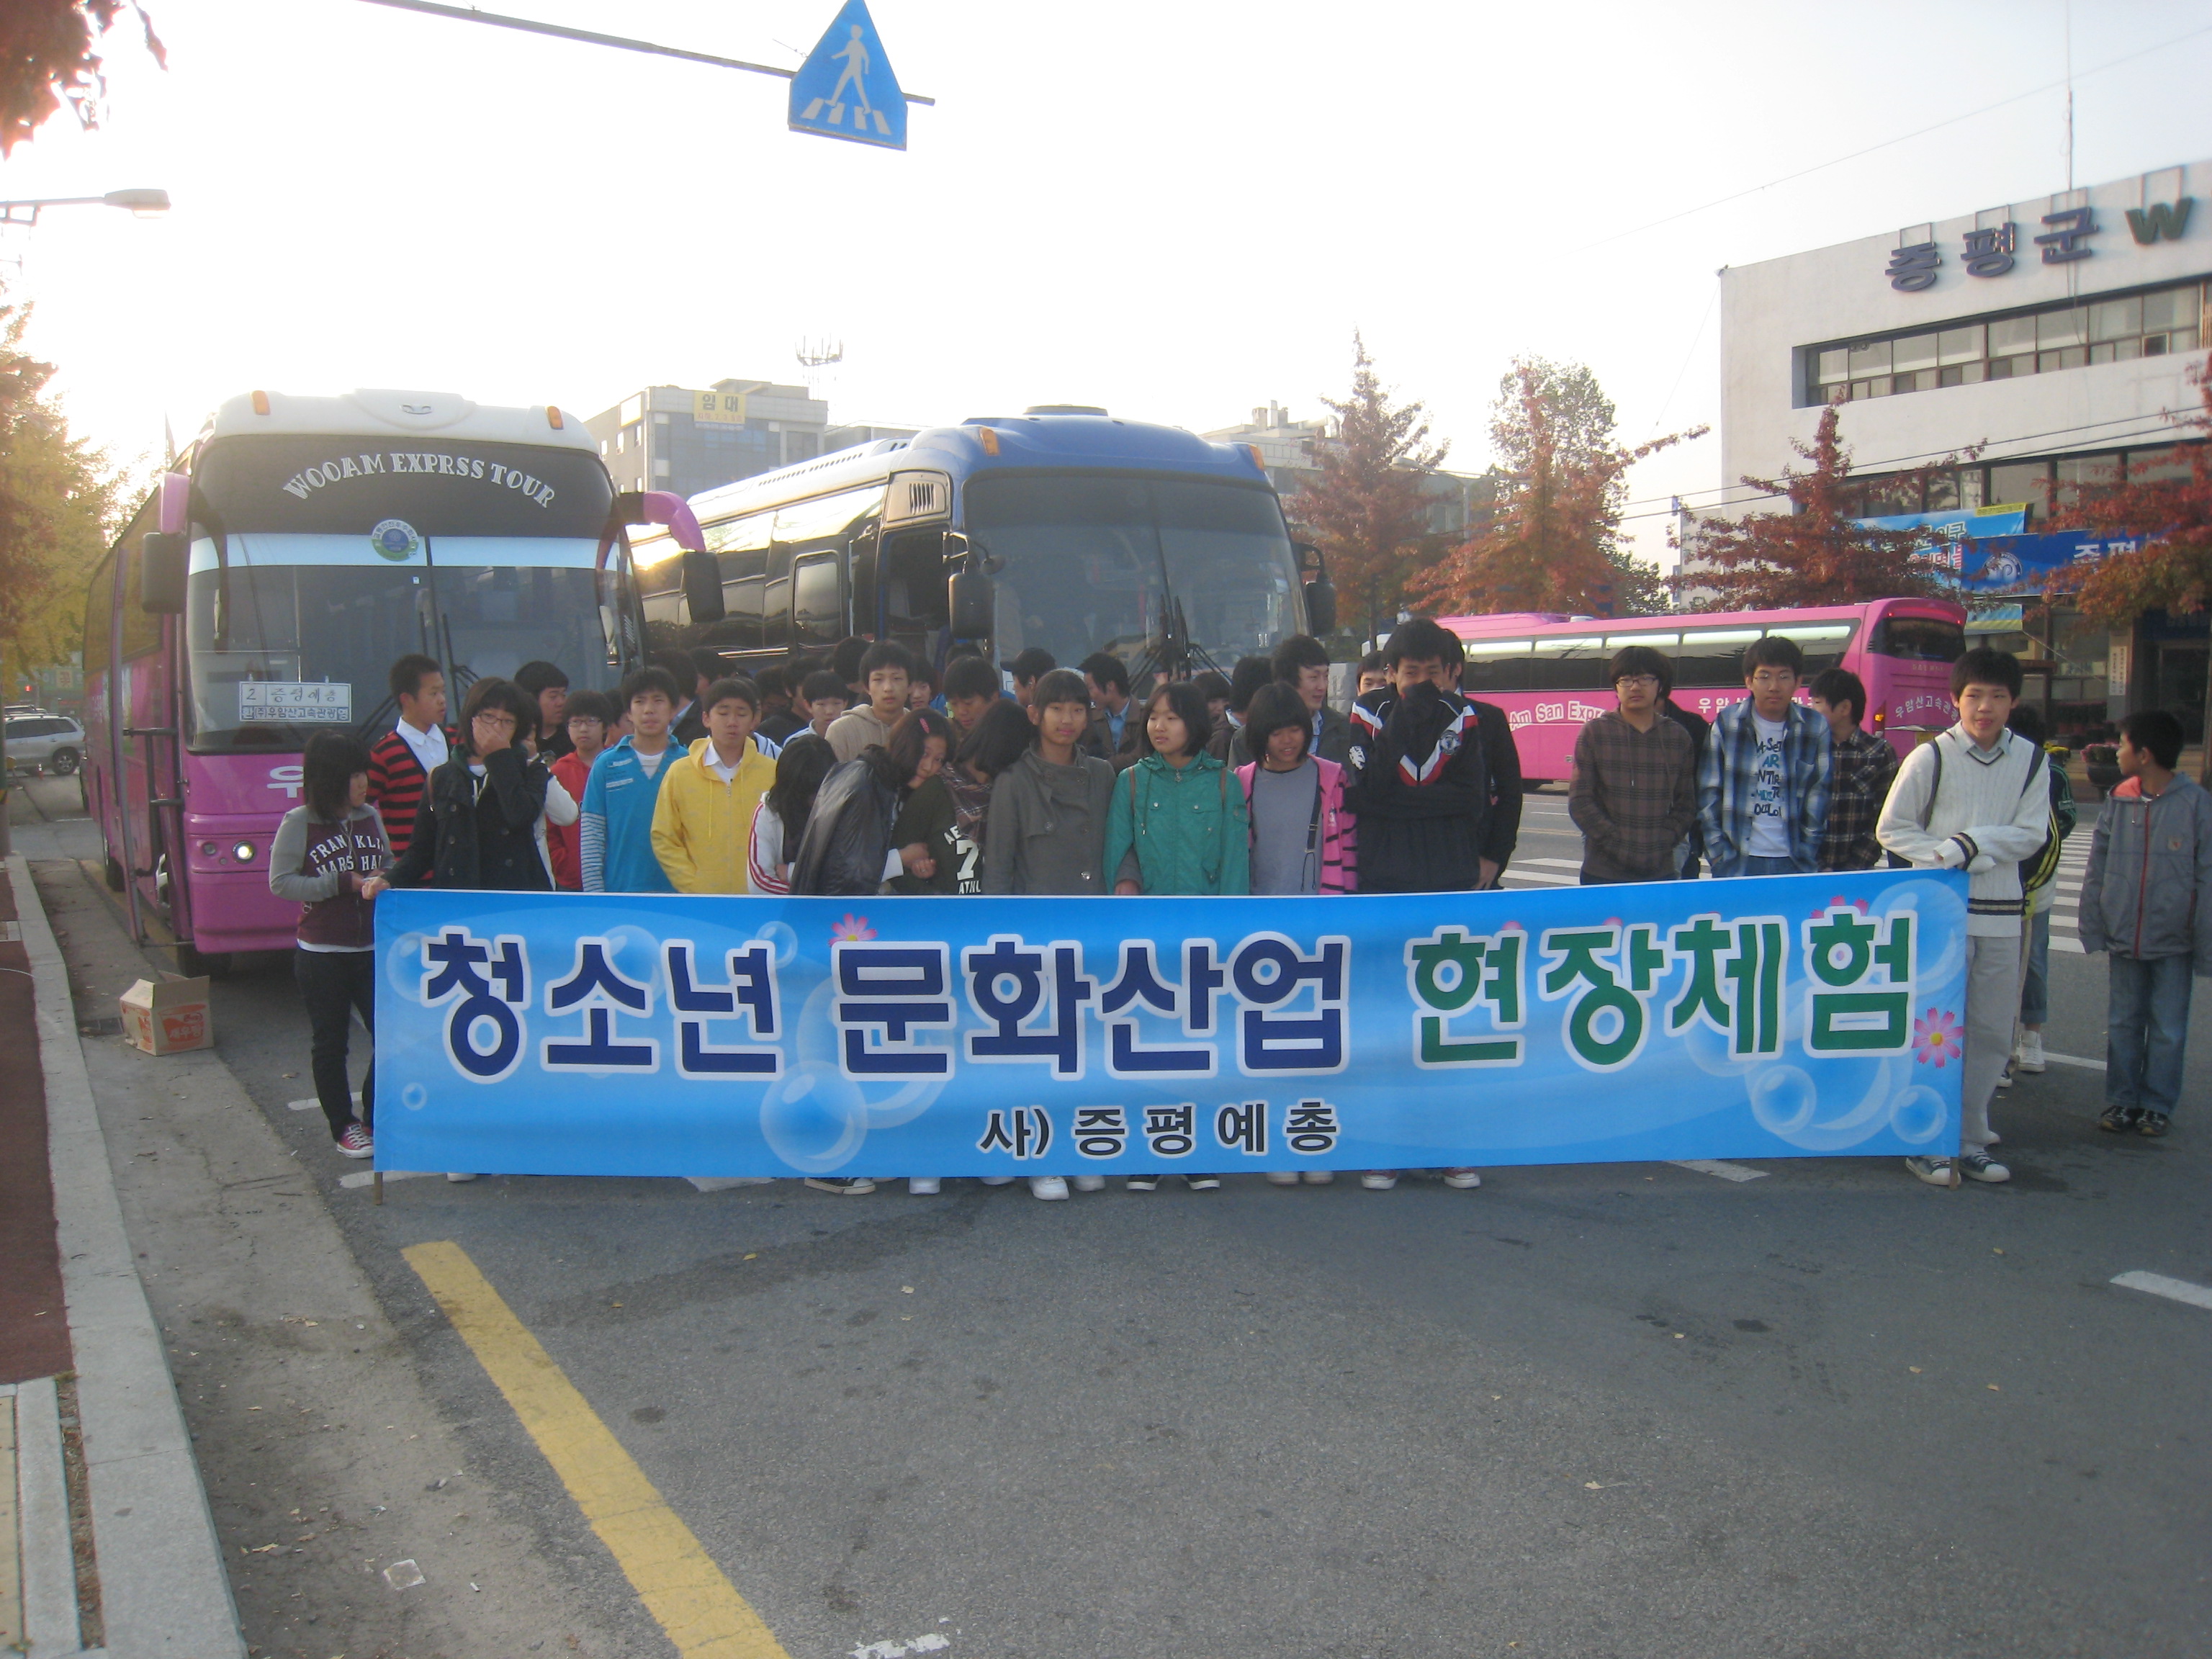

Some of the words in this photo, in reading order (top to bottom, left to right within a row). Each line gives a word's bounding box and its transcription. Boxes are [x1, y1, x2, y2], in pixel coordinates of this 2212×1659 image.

[1884, 205, 2100, 292] 증평군
[702, 394, 739, 413] 임대
[282, 453, 386, 500] WOOAM
[390, 452, 485, 480] EXPRSS
[491, 462, 555, 508] TOUR
[246, 688, 256, 701] 2
[1535, 703, 1565, 724] San
[424, 930, 781, 1079] 청소년
[835, 935, 1347, 1077] 문화산업
[1408, 909, 1915, 1069] 현장체험
[979, 1107, 1052, 1158] 사)
[1074, 1101, 1339, 1156] 증평예총
